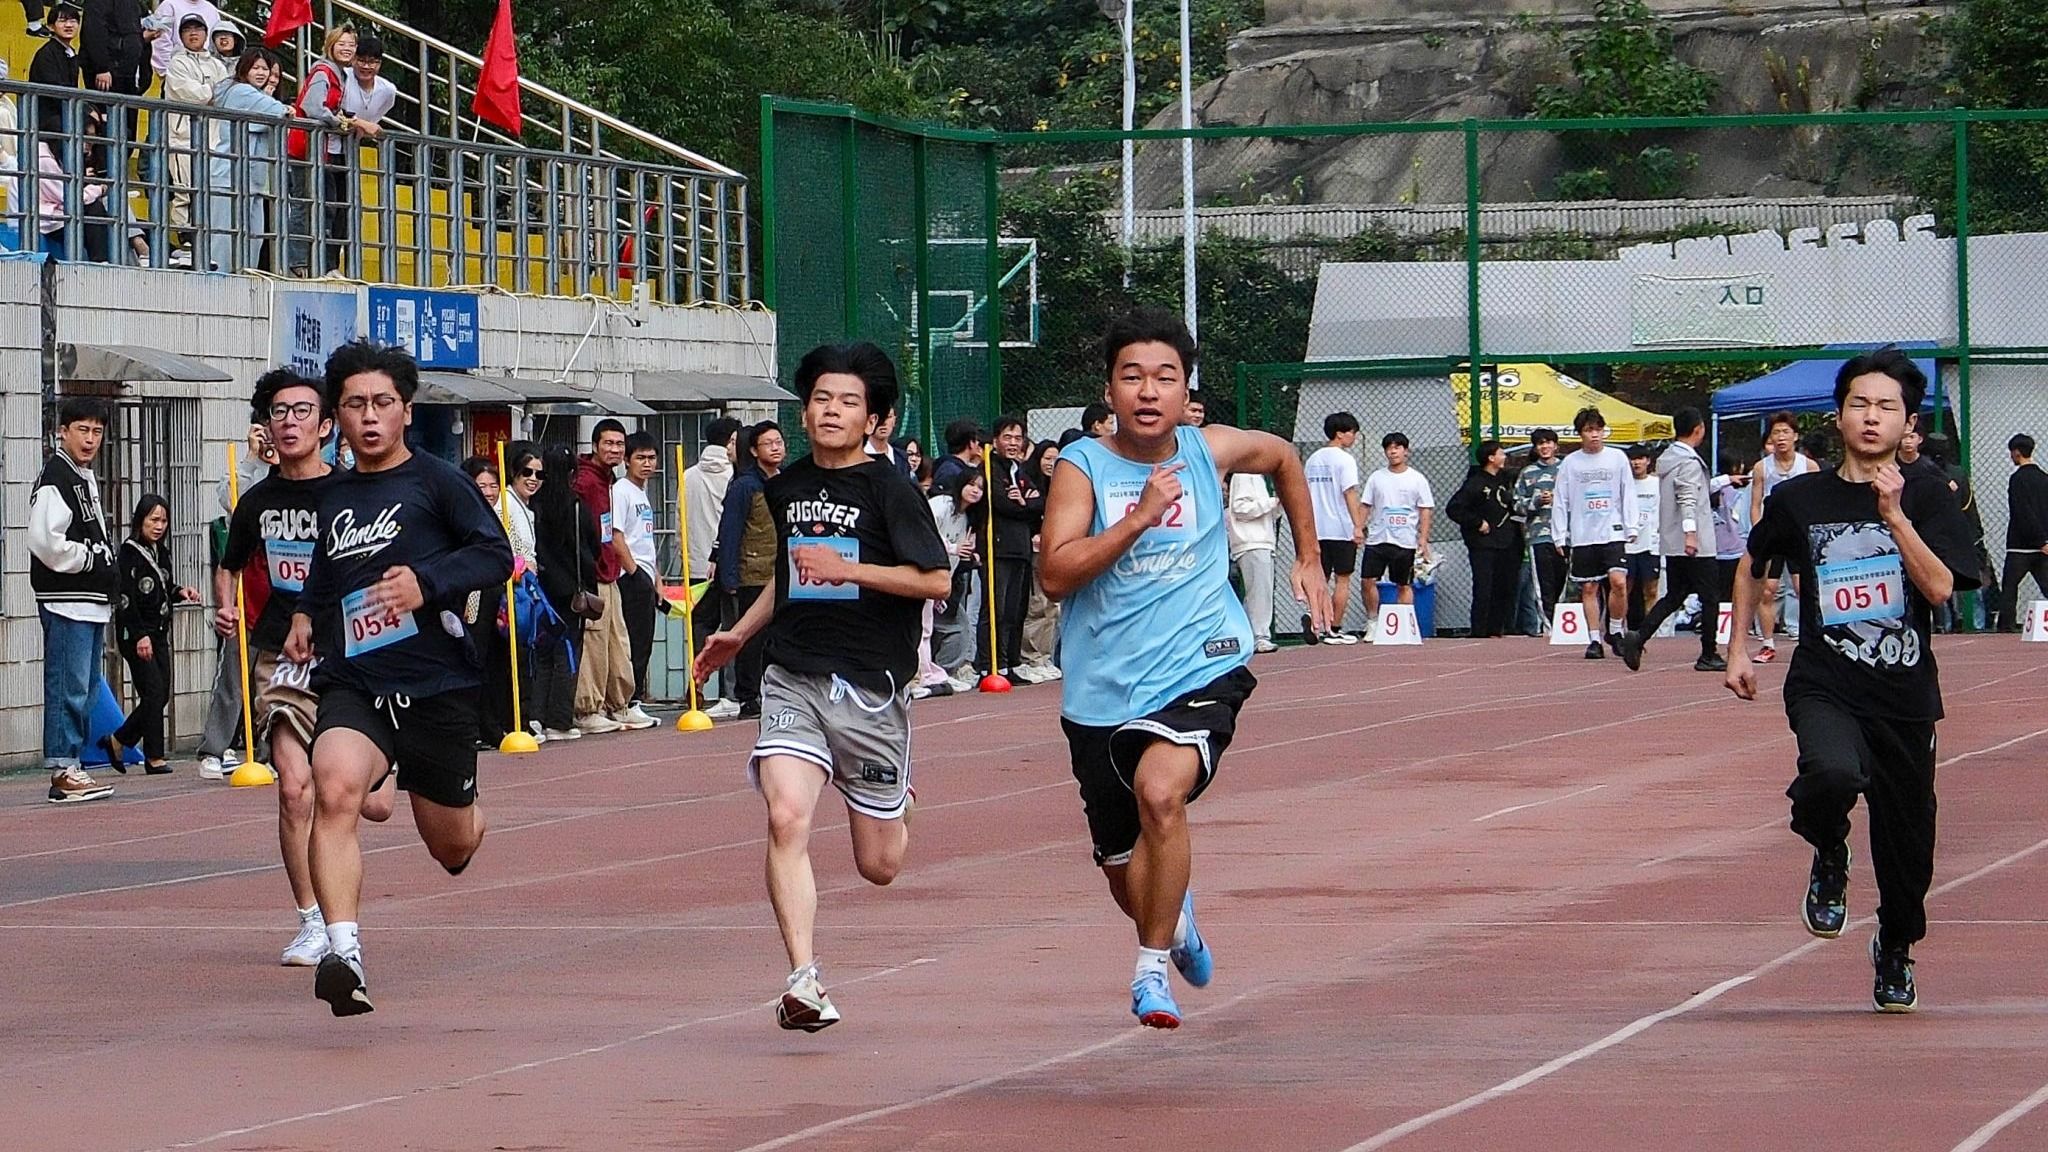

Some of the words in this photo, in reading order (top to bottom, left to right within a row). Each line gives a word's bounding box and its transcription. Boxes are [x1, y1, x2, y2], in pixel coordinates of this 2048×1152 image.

[1719, 284, 1763, 306] 入口
[441, 308, 456, 321] POCARI
[441, 321, 455, 335] SWEAT
[786, 500, 861, 529] RIGORER
[1587, 500, 1609, 510] 064
[1388, 516, 1408, 526] 069
[1835, 582, 1890, 612] 051
[351, 606, 402, 643] 054
[1386, 612, 1399, 636] 9
[1562, 611, 1577, 634] 8
[1718, 611, 1734, 634] 7
[2026, 609, 2034, 633] 5
